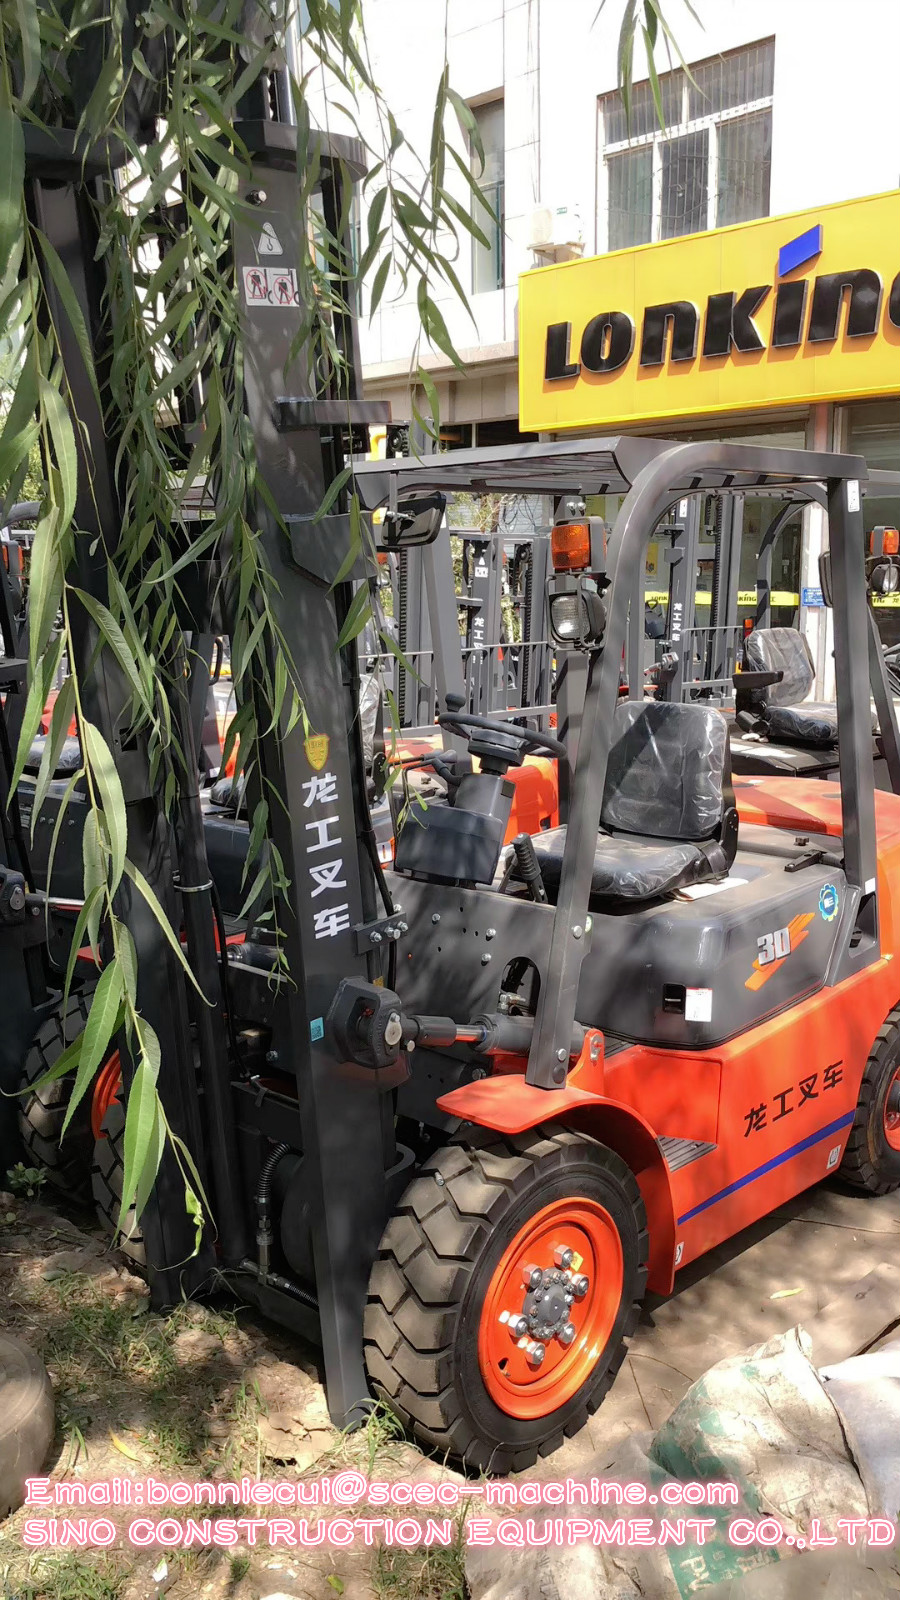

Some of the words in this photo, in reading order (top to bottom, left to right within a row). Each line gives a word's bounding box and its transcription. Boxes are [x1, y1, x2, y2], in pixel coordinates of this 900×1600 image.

[302, 772, 350, 940] 龙工叉车
[757, 927, 791, 966] 30
[744, 1060, 843, 1137] 龙工叉车
